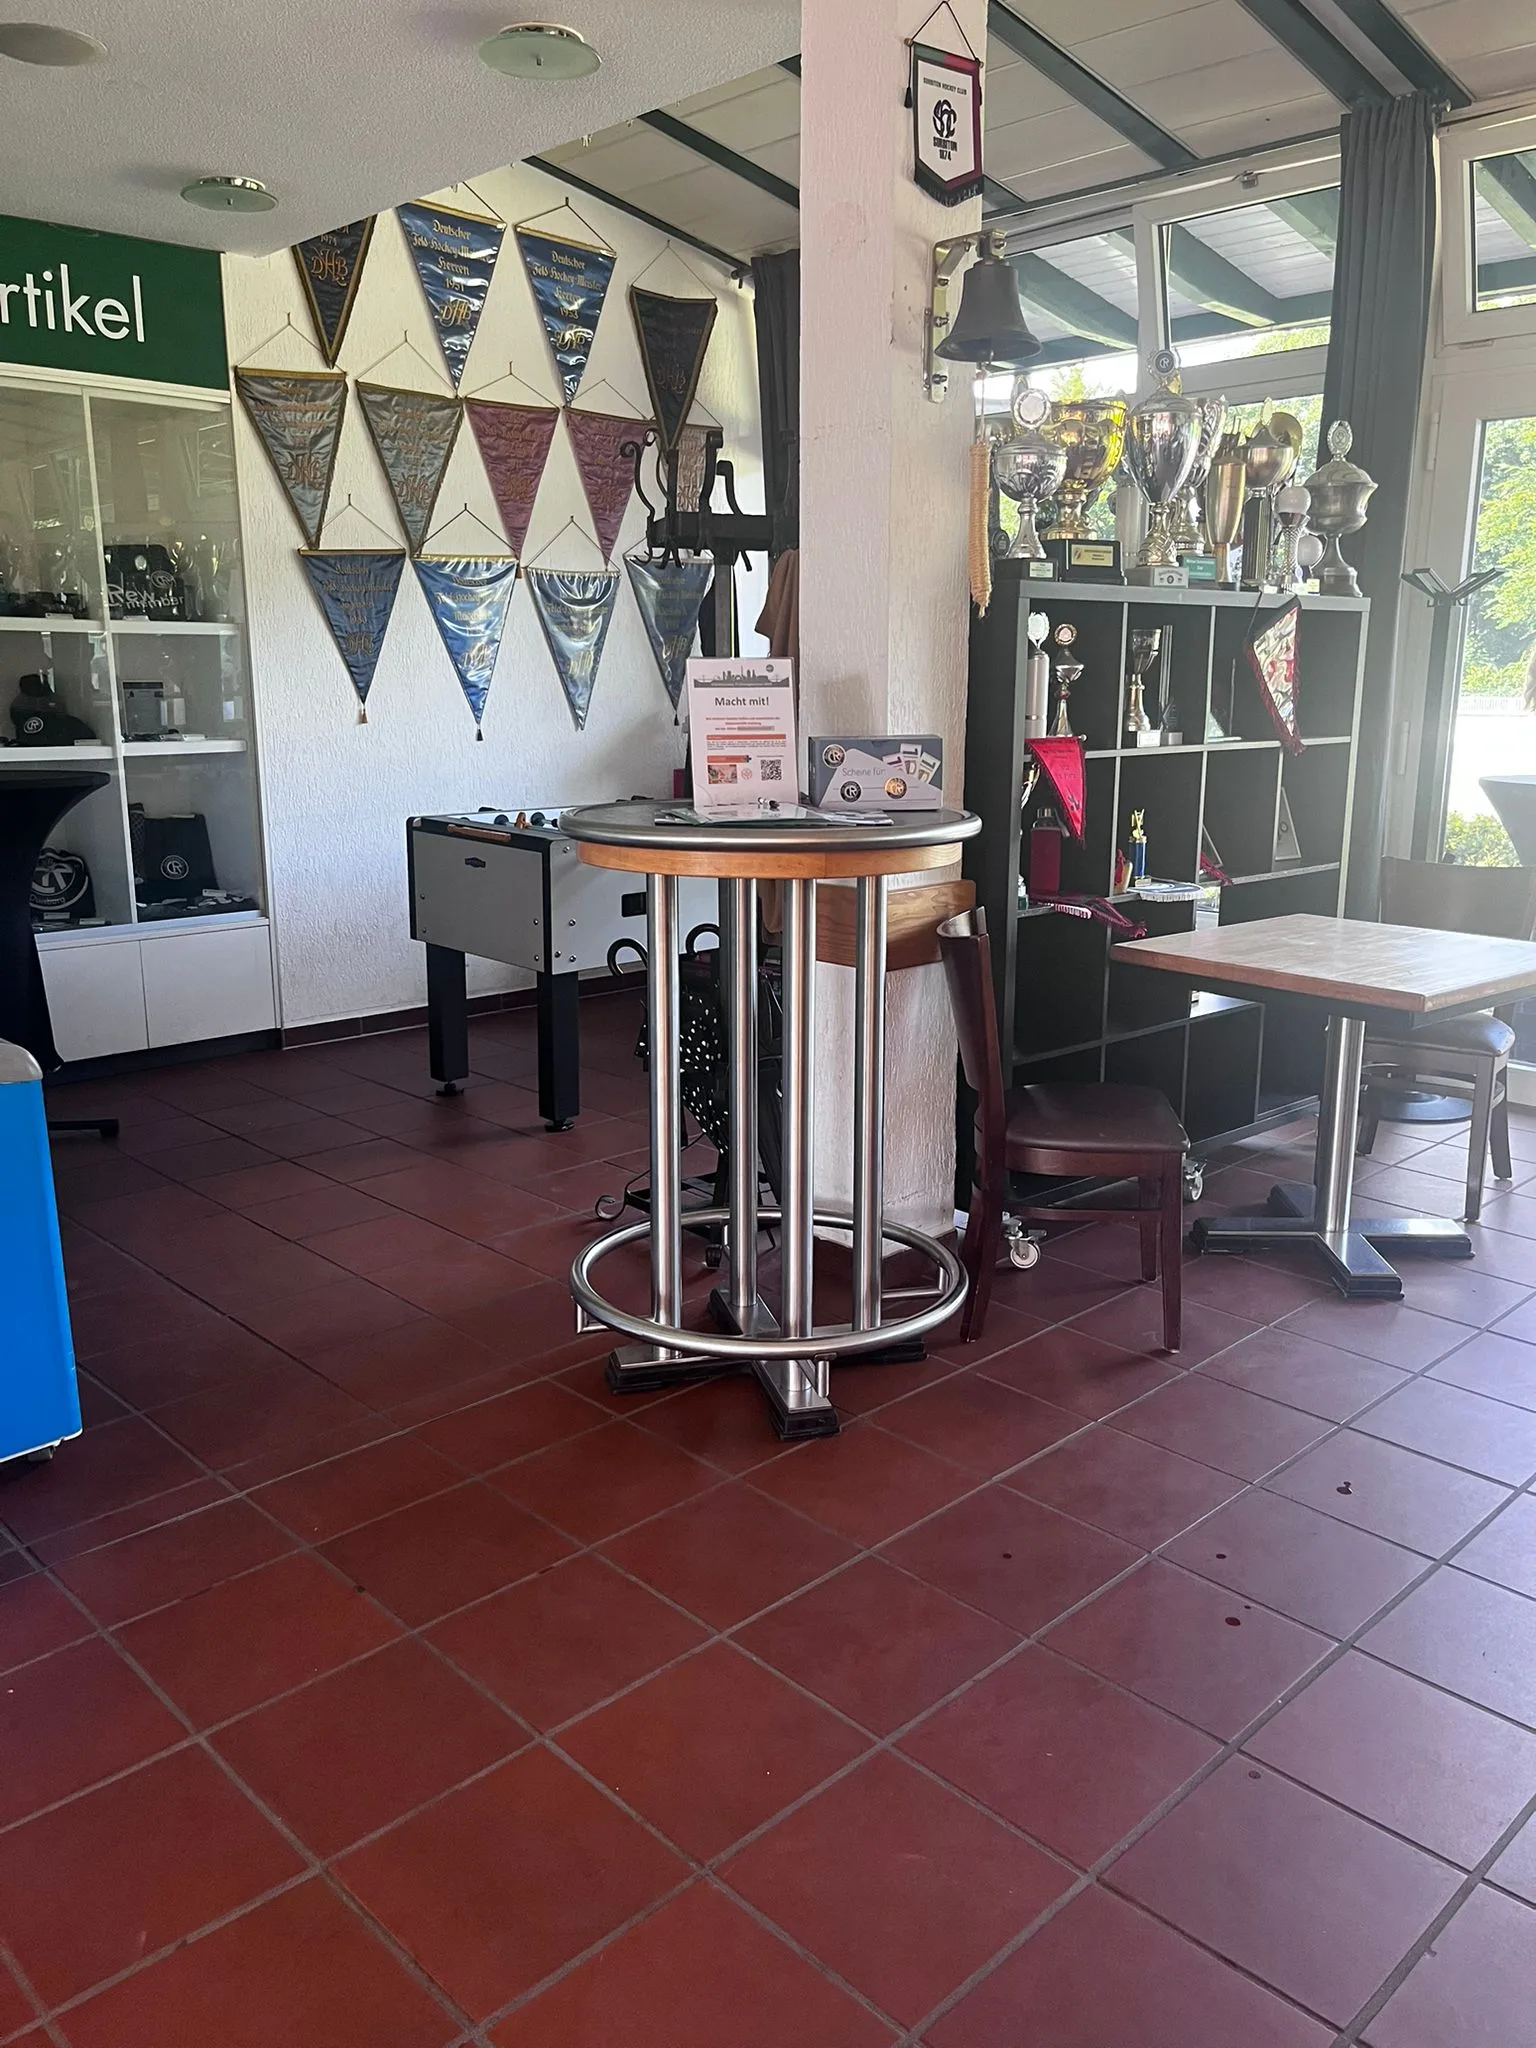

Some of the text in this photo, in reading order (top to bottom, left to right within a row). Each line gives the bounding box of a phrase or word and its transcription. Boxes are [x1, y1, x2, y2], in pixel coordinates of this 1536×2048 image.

[433, 219, 471, 239] Deutscher
[438, 256, 470, 275] Herren
[714, 696, 769, 706] Macht mit!
[842, 766, 871, 777] Scheine
